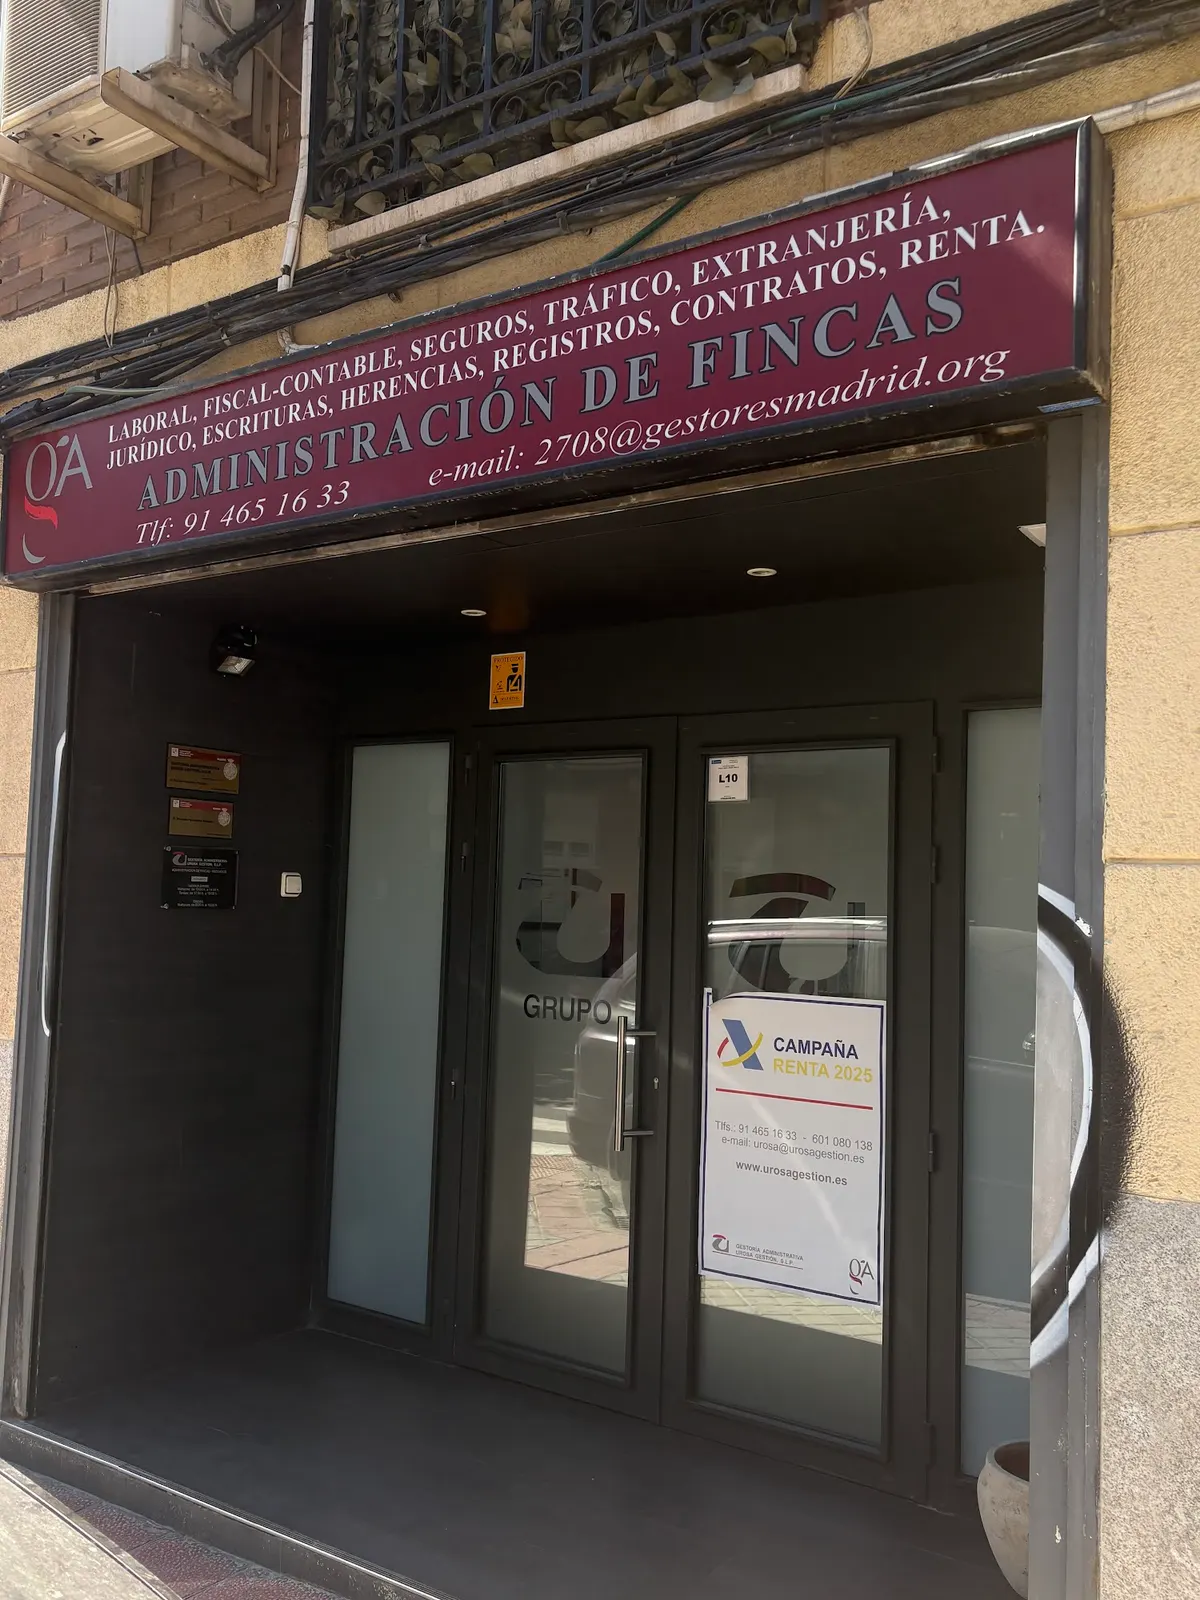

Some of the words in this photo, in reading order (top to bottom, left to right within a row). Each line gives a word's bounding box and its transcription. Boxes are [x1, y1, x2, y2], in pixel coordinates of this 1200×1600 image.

[108, 405, 198, 444] LABORAL,
[203, 346, 403, 417] FISCAL-CONTABLE,
[410, 310, 535, 362] SEGUROS,
[544, 270, 681, 327] TRÁFICO,
[692, 192, 951, 287] EXTRANJERÍA,
[106, 431, 197, 470] JURÍDICO,
[202, 395, 333, 446] ESCRITURAS,
[340, 356, 484, 412] HERENCIAS,
[493, 310, 661, 373] REGISTROS,
[670, 250, 887, 327] CONTRATOS,
[899, 209, 1046, 269] RENTA.
[137, 375, 558, 511] ADMINISTRACIÓN
[580, 352, 660, 414] DE
[687, 277, 965, 390] FINCAS
[428, 446, 525, 487] e-mail:
[534, 349, 1011, 466] 2708@gestoresmadrid.org
[136, 516, 173, 547] Tlf:
[183, 510, 208, 535] 91
[220, 499, 265, 528] 465
[276, 488, 308, 517] 16
[317, 480, 351, 510] 33
[718, 773, 738, 784] L10
[523, 993, 612, 1025] GRUPO
[773, 1037, 859, 1060] CAMPAÑA
[773, 1058, 830, 1078] RENTA
[834, 1064, 873, 1084] 2025
[715, 1120, 737, 1133] Tlfs.:
[738, 1124, 749, 1134] 91
[752, 1125, 770, 1137] 465
[773, 1128, 783, 1139] 16
[785, 1129, 798, 1141] 33
[812, 1133, 830, 1145] 601
[833, 1136, 852, 1149] 080
[855, 1138, 873, 1151] 138
[721, 1135, 751, 1148] e-mail:
[753, 1139, 865, 1164] urosa@urosagestion.es
[735, 1161, 848, 1186] www.urosagestion.es
